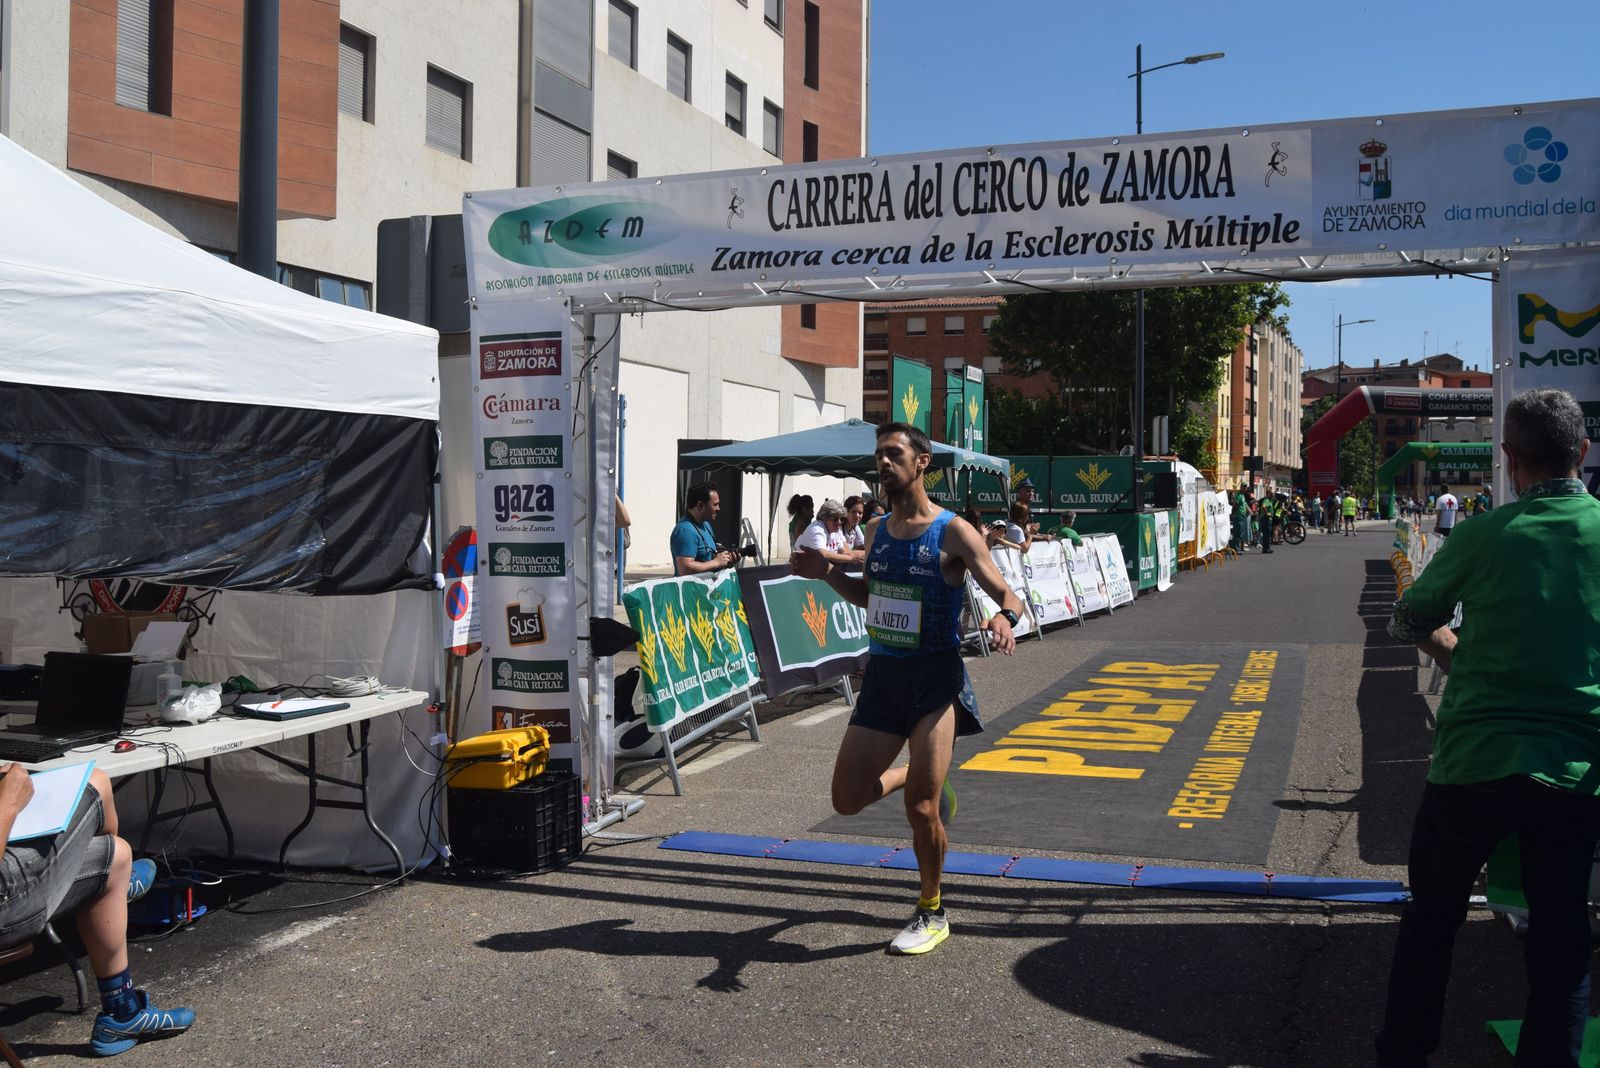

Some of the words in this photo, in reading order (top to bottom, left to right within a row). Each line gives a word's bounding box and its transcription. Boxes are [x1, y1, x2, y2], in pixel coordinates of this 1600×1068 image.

[767, 169, 896, 232] CARRERA
[903, 164, 944, 219] del
[952, 156, 1049, 217] CERCO
[1057, 151, 1090, 208] de
[1099, 142, 1236, 205] ZAMORA
[1323, 200, 1427, 218] AYUNTAMIENTO
[1444, 204, 1472, 222] dia
[1475, 200, 1549, 219] mundial
[1552, 198, 1577, 217] de
[1580, 197, 1597, 214] la
[1322, 216, 1344, 233] DE
[1348, 213, 1427, 232] ZAMORA
[710, 245, 822, 272] Zamora
[831, 243, 911, 267] cerca
[920, 234, 955, 264] de
[965, 231, 994, 261] la
[1002, 220, 1155, 260] Esclerosis
[1165, 210, 1301, 253] Múltiple
[537, 273, 584, 287] ZAMORANA
[587, 270, 600, 281] DE
[603, 267, 652, 281] ESCLEROSIS
[655, 262, 696, 277] MÚLTIPLE
[497, 348, 544, 358] DIPUTACIÓN
[545, 347, 557, 355] DE
[497, 356, 558, 371] ZAMORA
[1428, 393, 1447, 401] CON
[1449, 393, 1458, 401] EL
[511, 417, 534, 425] Zamora
[528, 455, 558, 466] RURAL
[1438, 462, 1479, 471] SALIDA
[494, 484, 555, 523] gaza
[977, 492, 1003, 502] CAJA
[1060, 493, 1087, 504] CAJA
[1089, 493, 1128, 504] RURAL
[529, 524, 555, 532] Zamora
[528, 564, 560, 574] RURAL
[510, 614, 540, 637] Susi
[881, 611, 909, 630] NIETO
[531, 679, 564, 690] RURAL
[958, 661, 1221, 780] PIDEPAR
[1202, 710, 1263, 753] INTEGRAL
[1167, 756, 1247, 819] REFORMA
